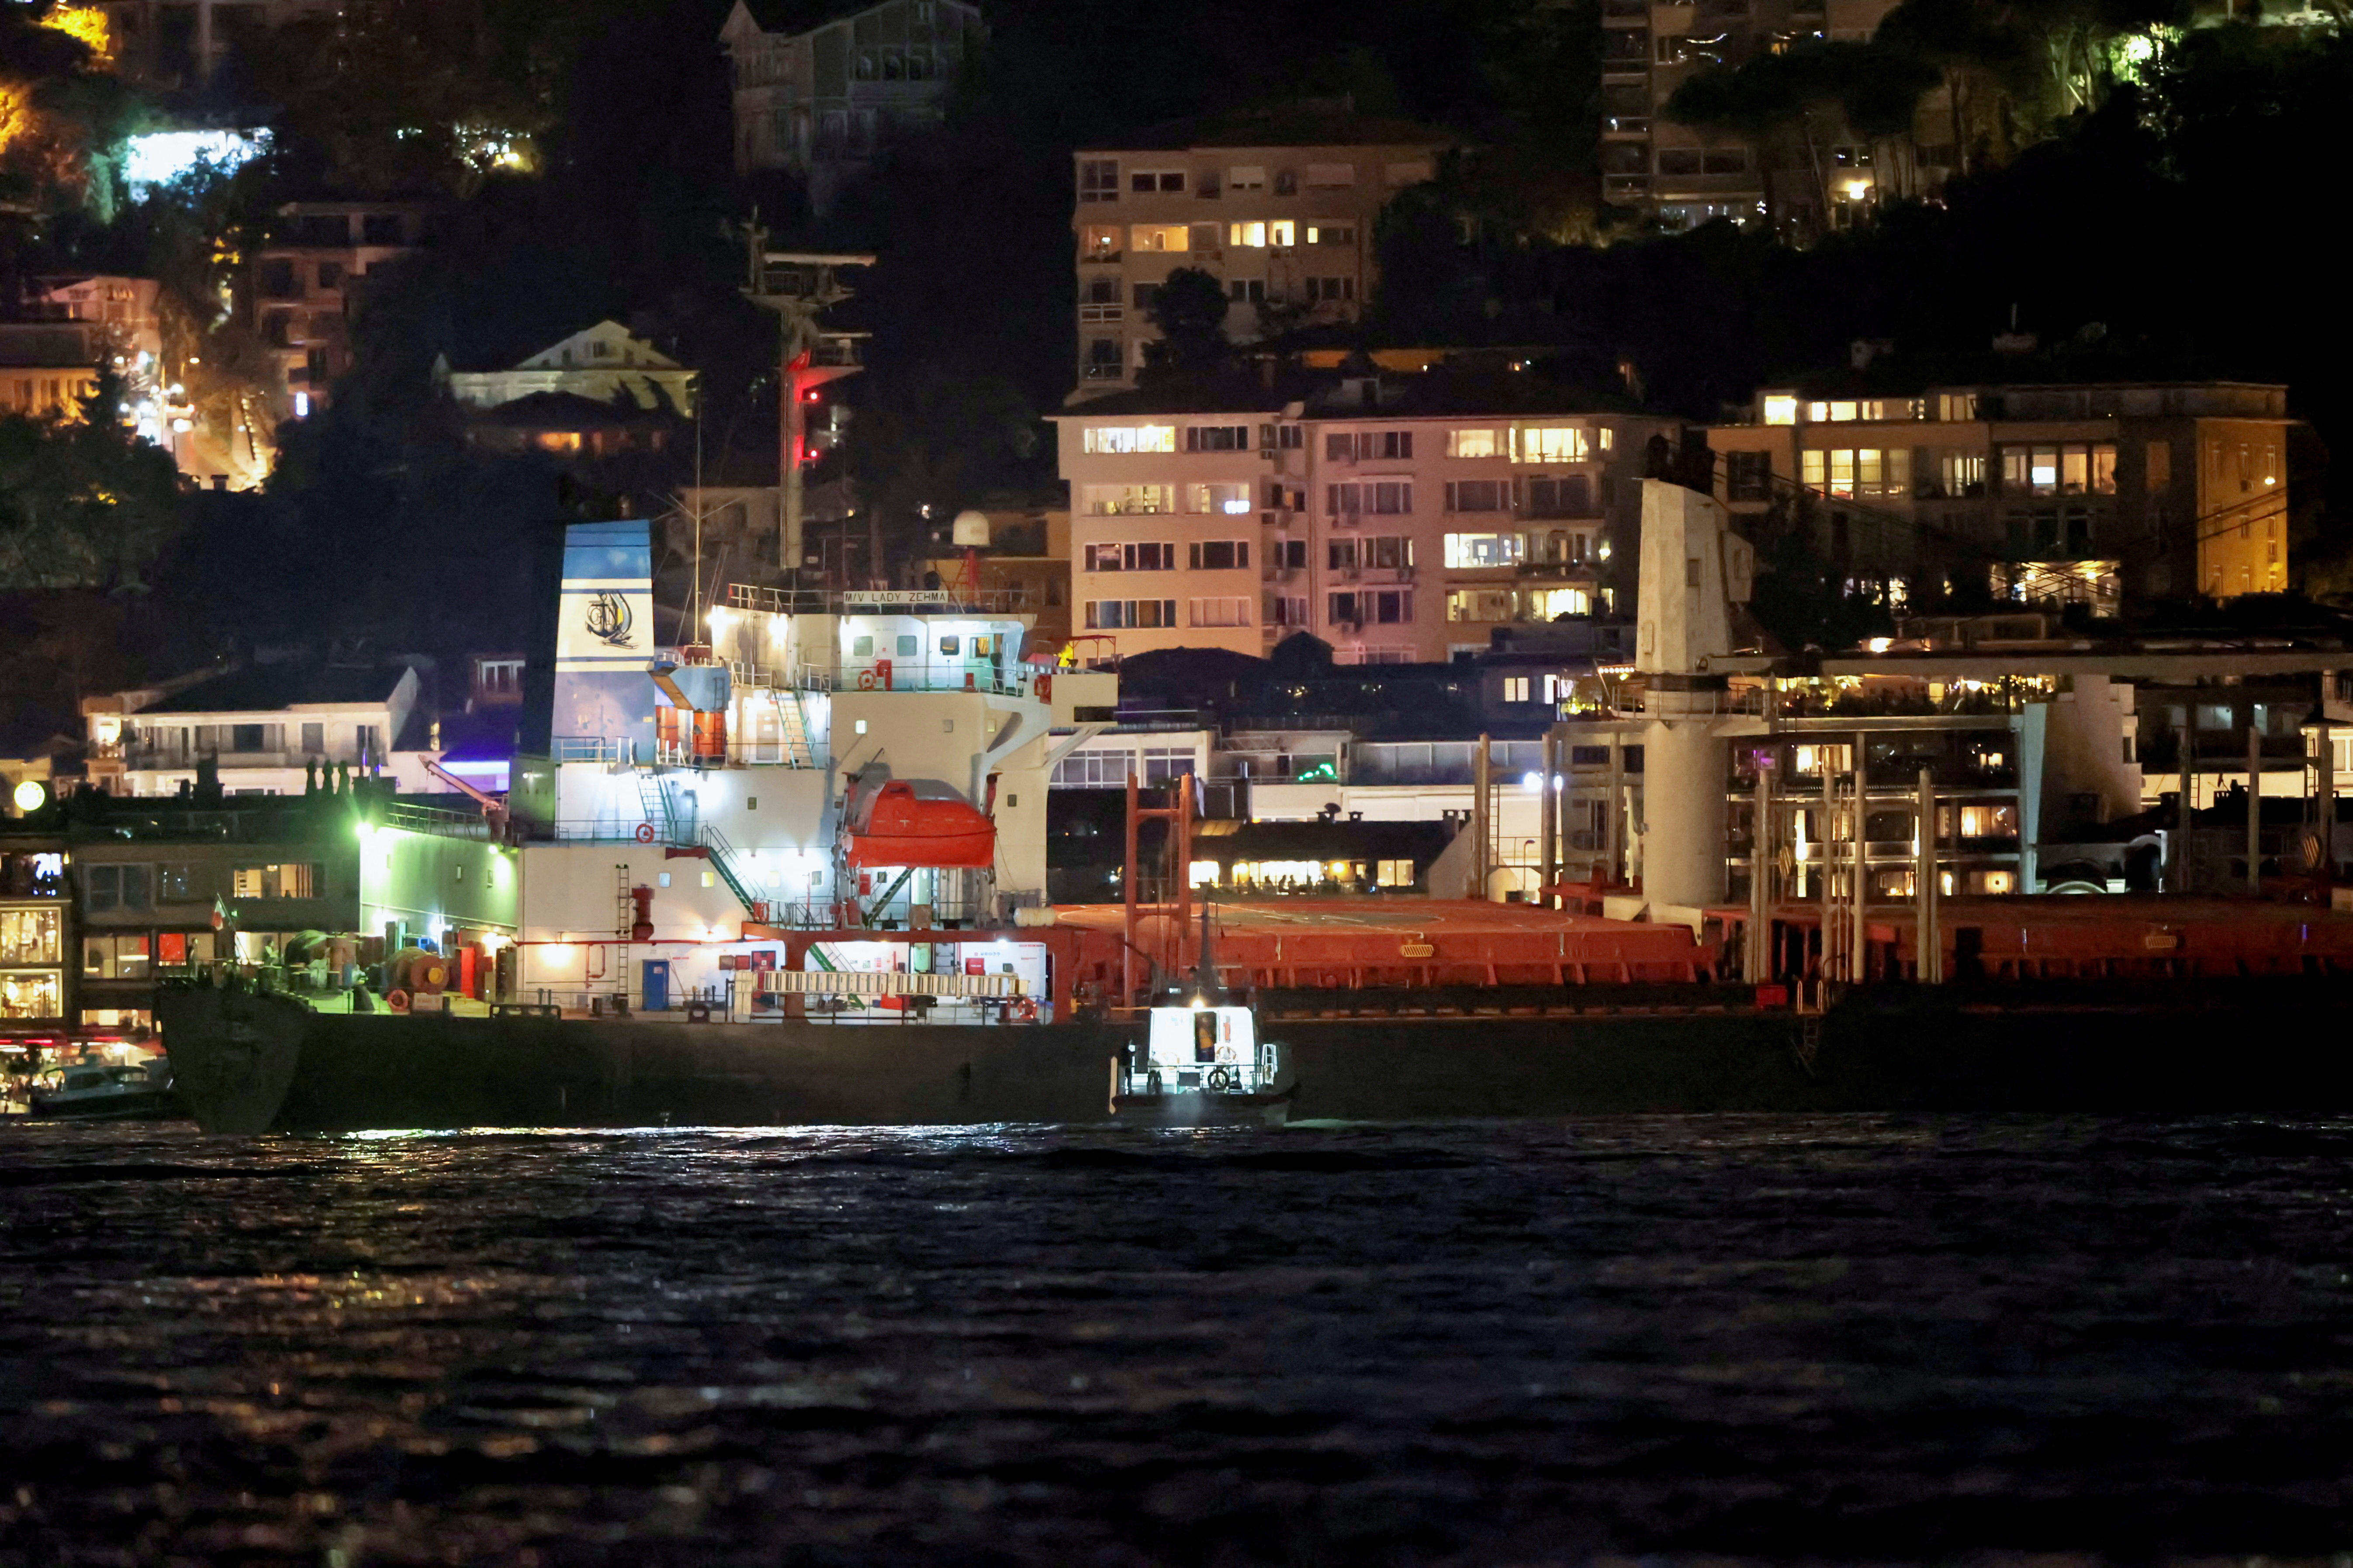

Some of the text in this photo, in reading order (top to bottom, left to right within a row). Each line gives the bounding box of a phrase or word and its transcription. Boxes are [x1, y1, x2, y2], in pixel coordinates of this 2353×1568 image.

[845, 592, 946, 602] M/V LADY ZEHMA
